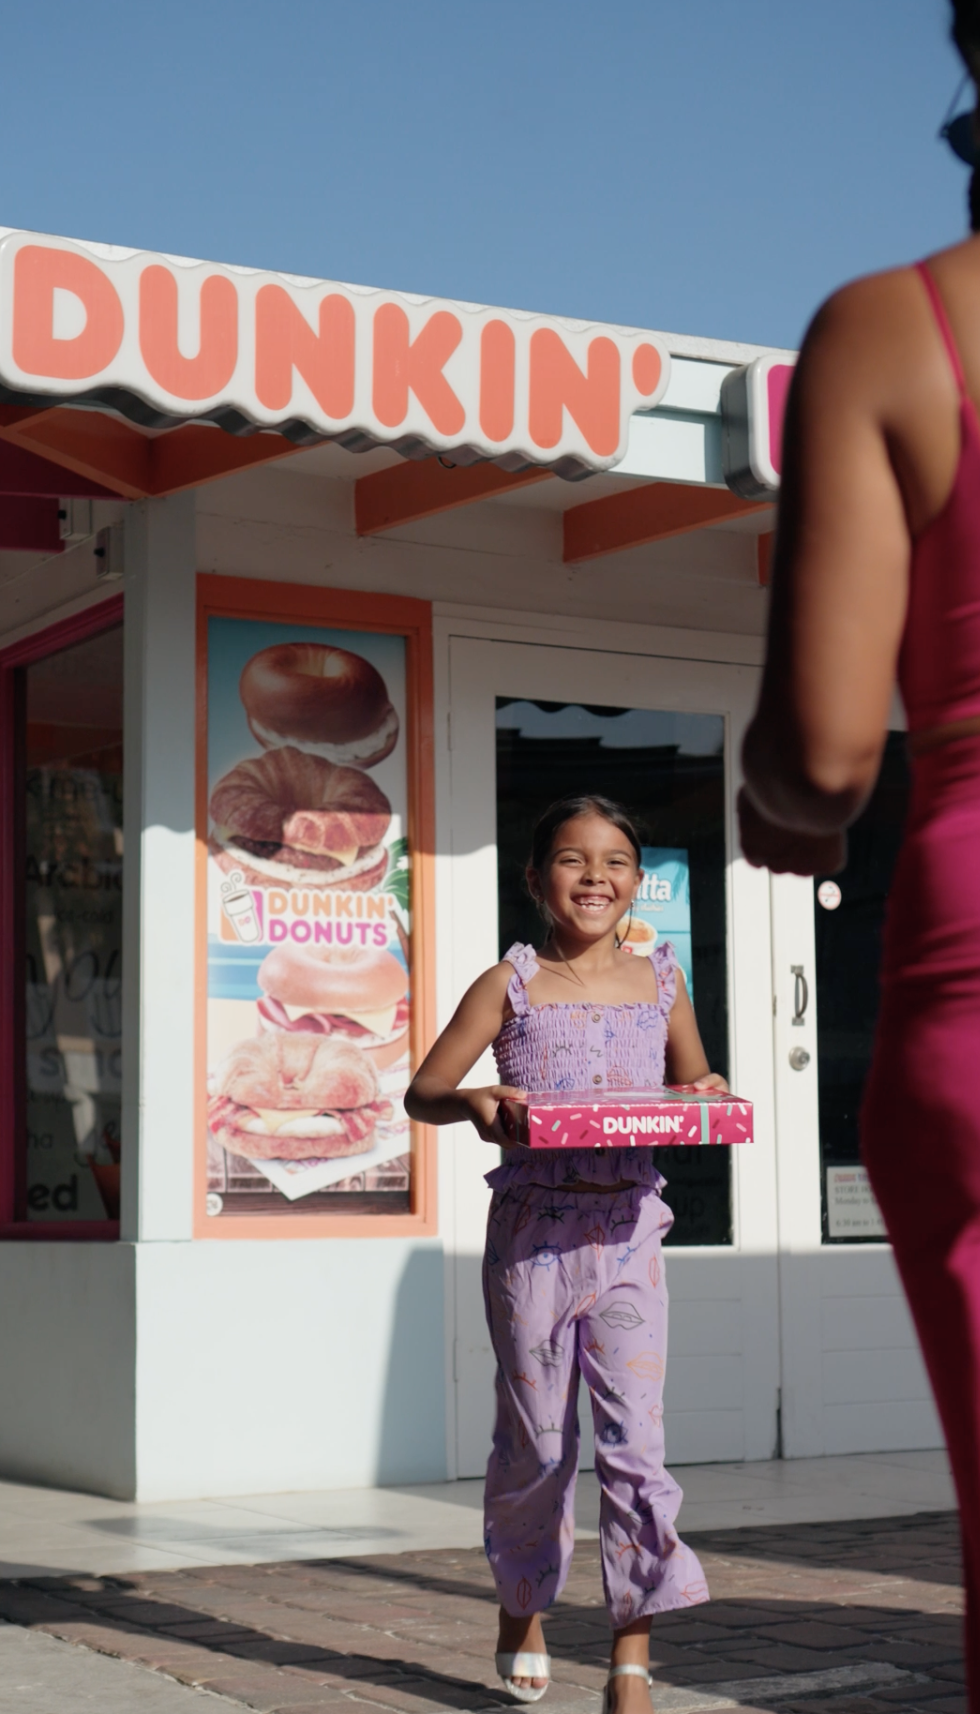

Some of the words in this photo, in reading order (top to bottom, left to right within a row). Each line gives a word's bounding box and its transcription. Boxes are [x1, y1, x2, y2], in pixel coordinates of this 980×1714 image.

[12, 244, 662, 457] DUNKIN'
[268, 891, 394, 919] DUNKIN'
[268, 919, 388, 946] DONUTS
[603, 1115, 684, 1134] DUNKIN'
